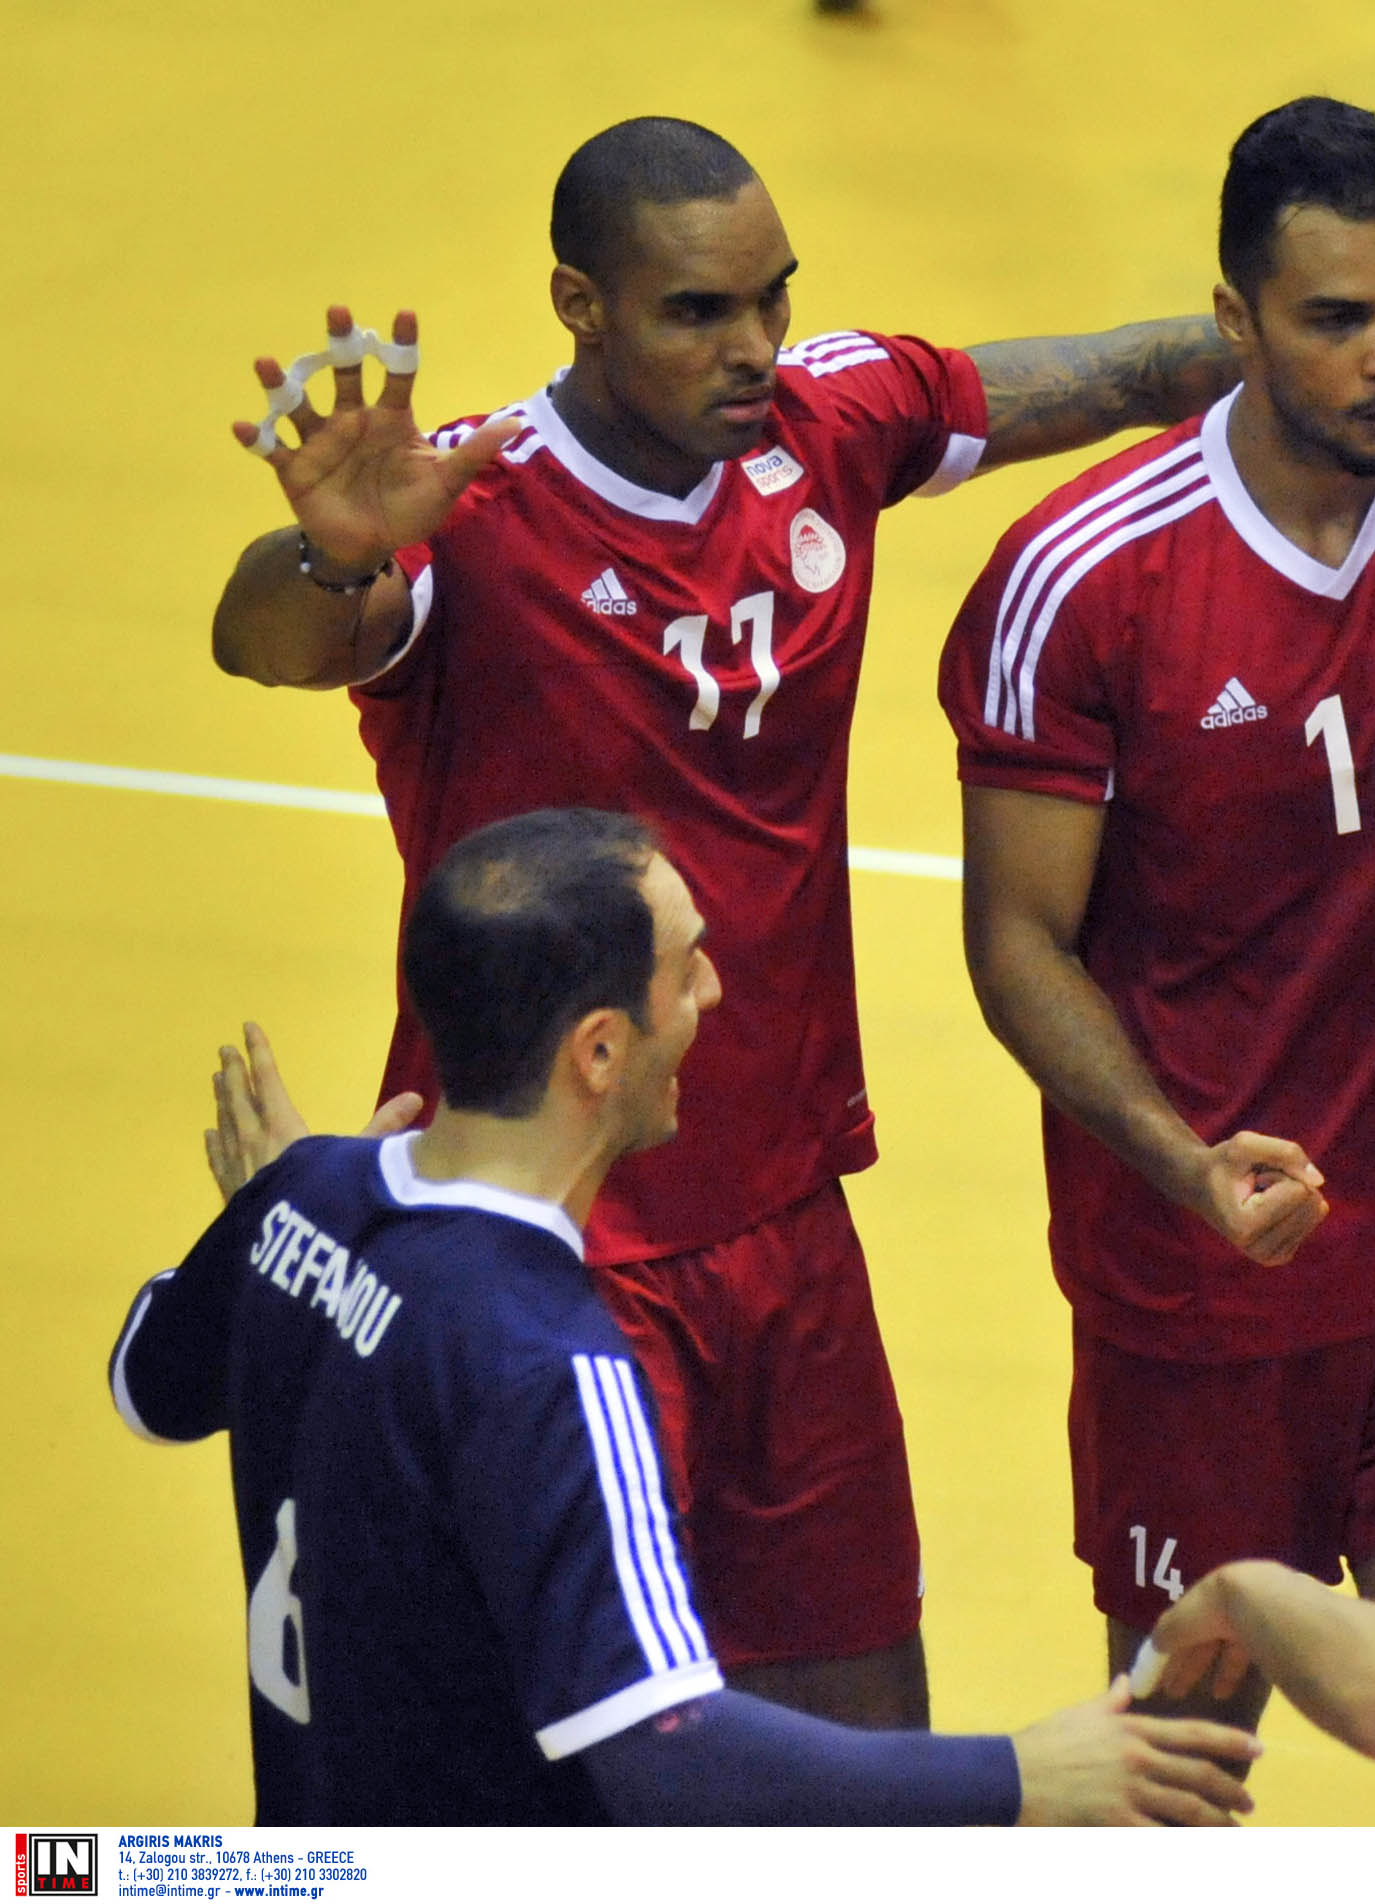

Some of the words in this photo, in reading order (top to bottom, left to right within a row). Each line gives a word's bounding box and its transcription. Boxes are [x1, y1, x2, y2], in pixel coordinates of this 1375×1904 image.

[746, 455, 783, 477] nova
[663, 591, 780, 739] 17
[1200, 704, 1268, 730] adidas
[1129, 1524, 1184, 1601] 14
[249, 1498, 311, 1725] 6
